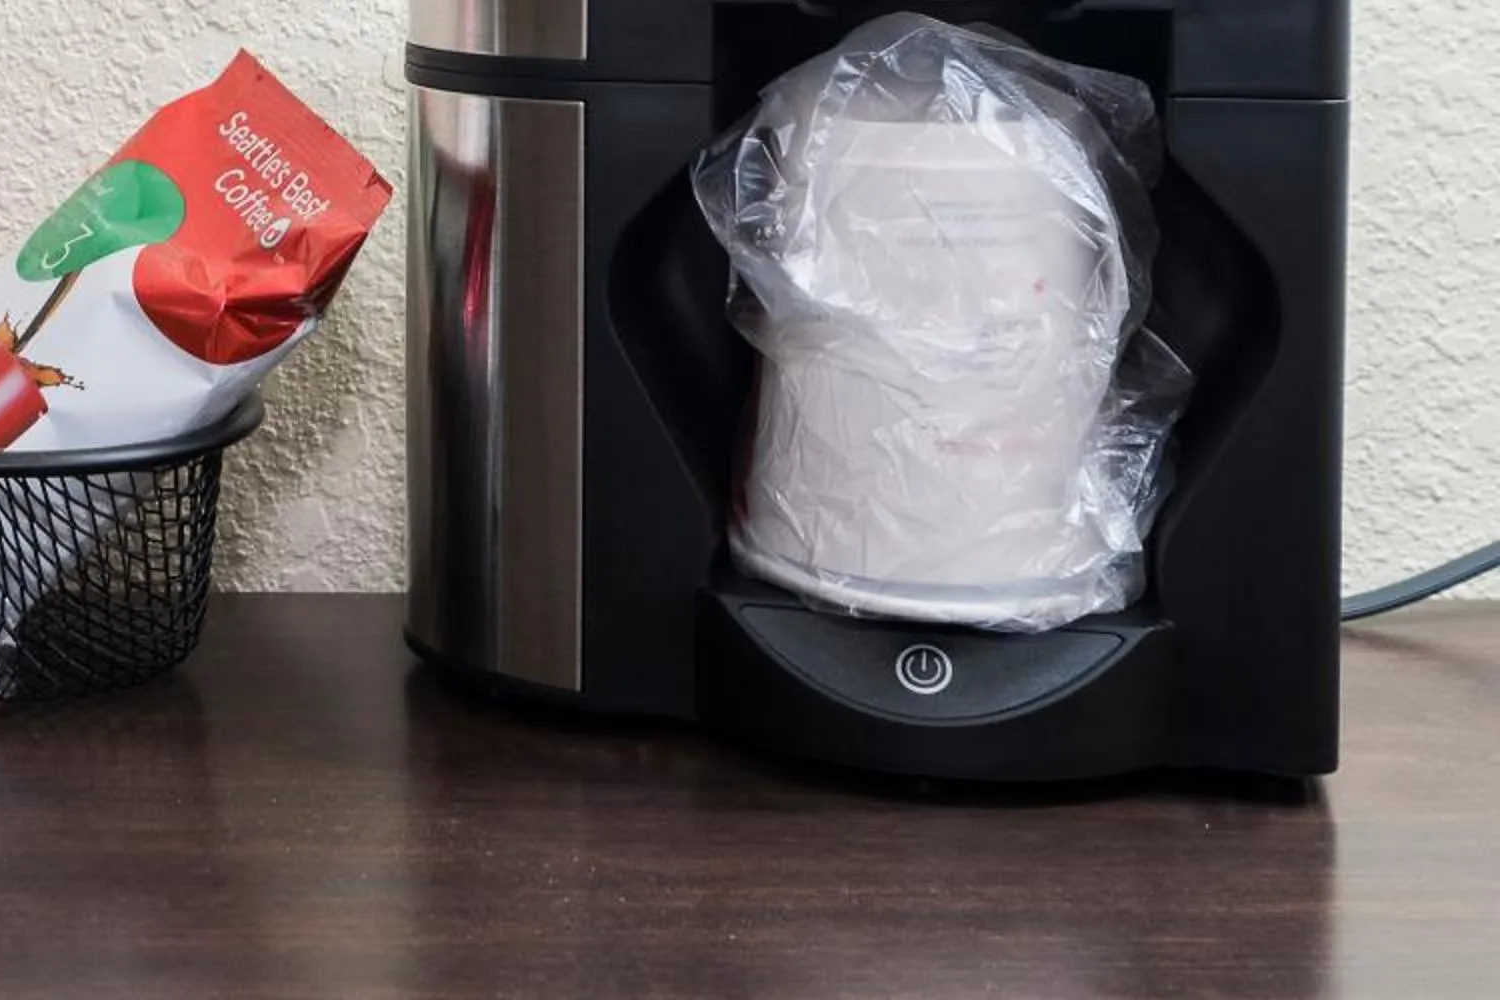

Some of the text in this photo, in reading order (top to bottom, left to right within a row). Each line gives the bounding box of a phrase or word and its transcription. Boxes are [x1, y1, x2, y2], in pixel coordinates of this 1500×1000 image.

[219, 111, 331, 221] Seattle's Best
[215, 169, 273, 233] Coffee
[41, 222, 95, 269] 3
